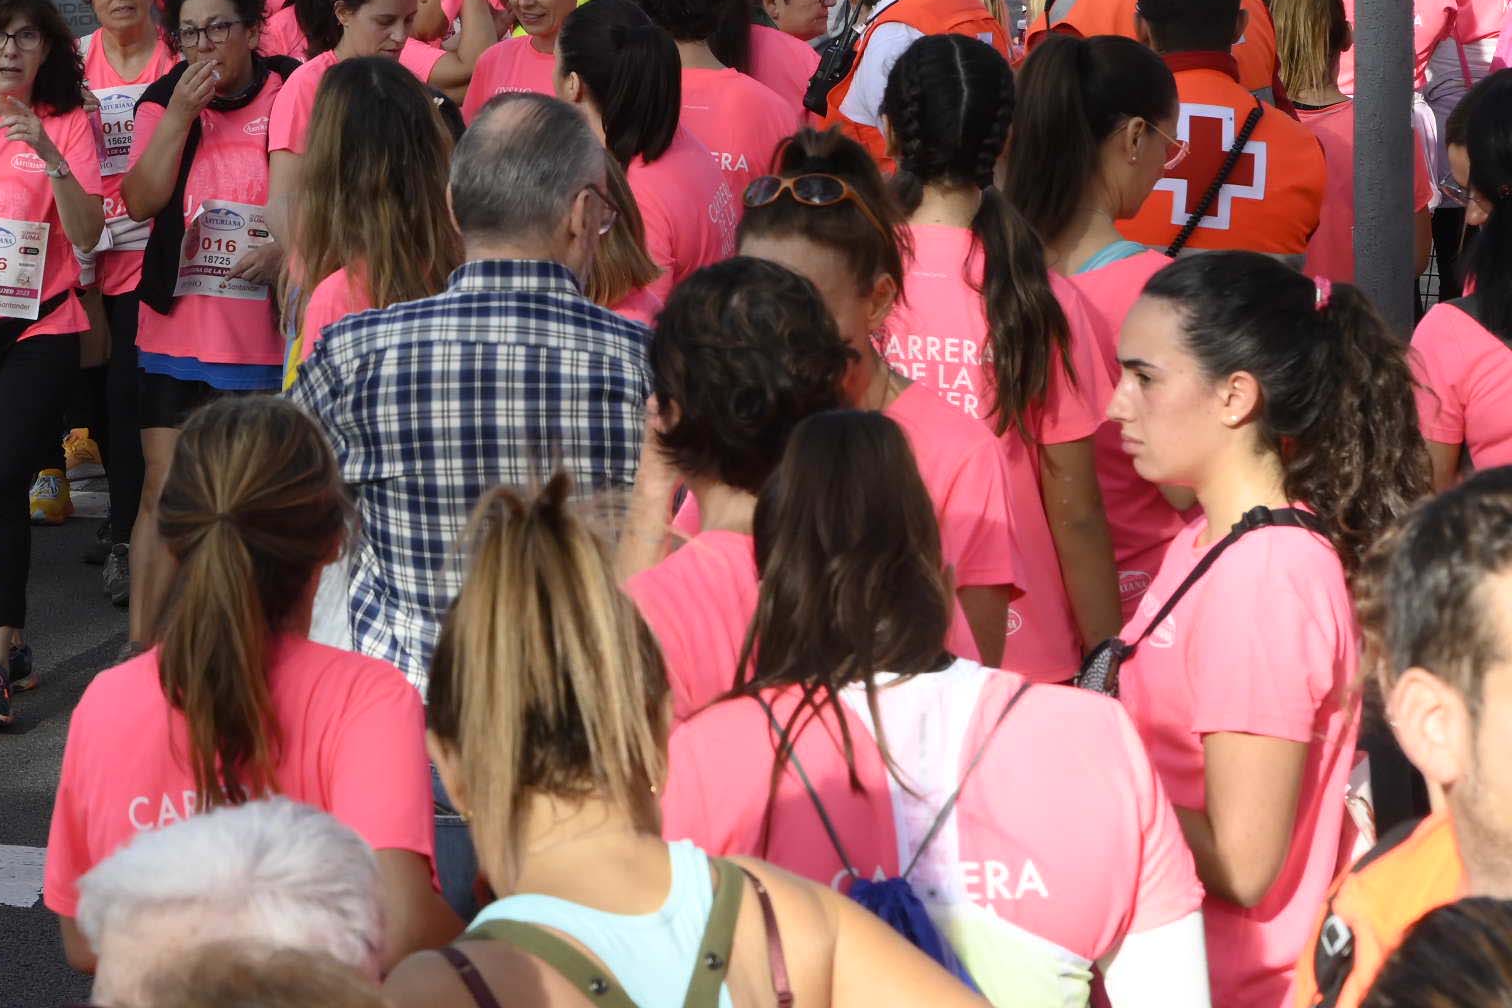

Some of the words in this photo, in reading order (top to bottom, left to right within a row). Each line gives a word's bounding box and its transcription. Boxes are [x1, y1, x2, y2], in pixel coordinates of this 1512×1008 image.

[103, 119, 135, 134] 016
[108, 135, 133, 146] 15628
[205, 216, 241, 227] ASTURIANA
[202, 237, 237, 253] 016
[203, 254, 231, 266] 18725
[884, 334, 994, 365] ARRERA
[937, 364, 975, 391] LA
[831, 858, 1049, 900] CERA
